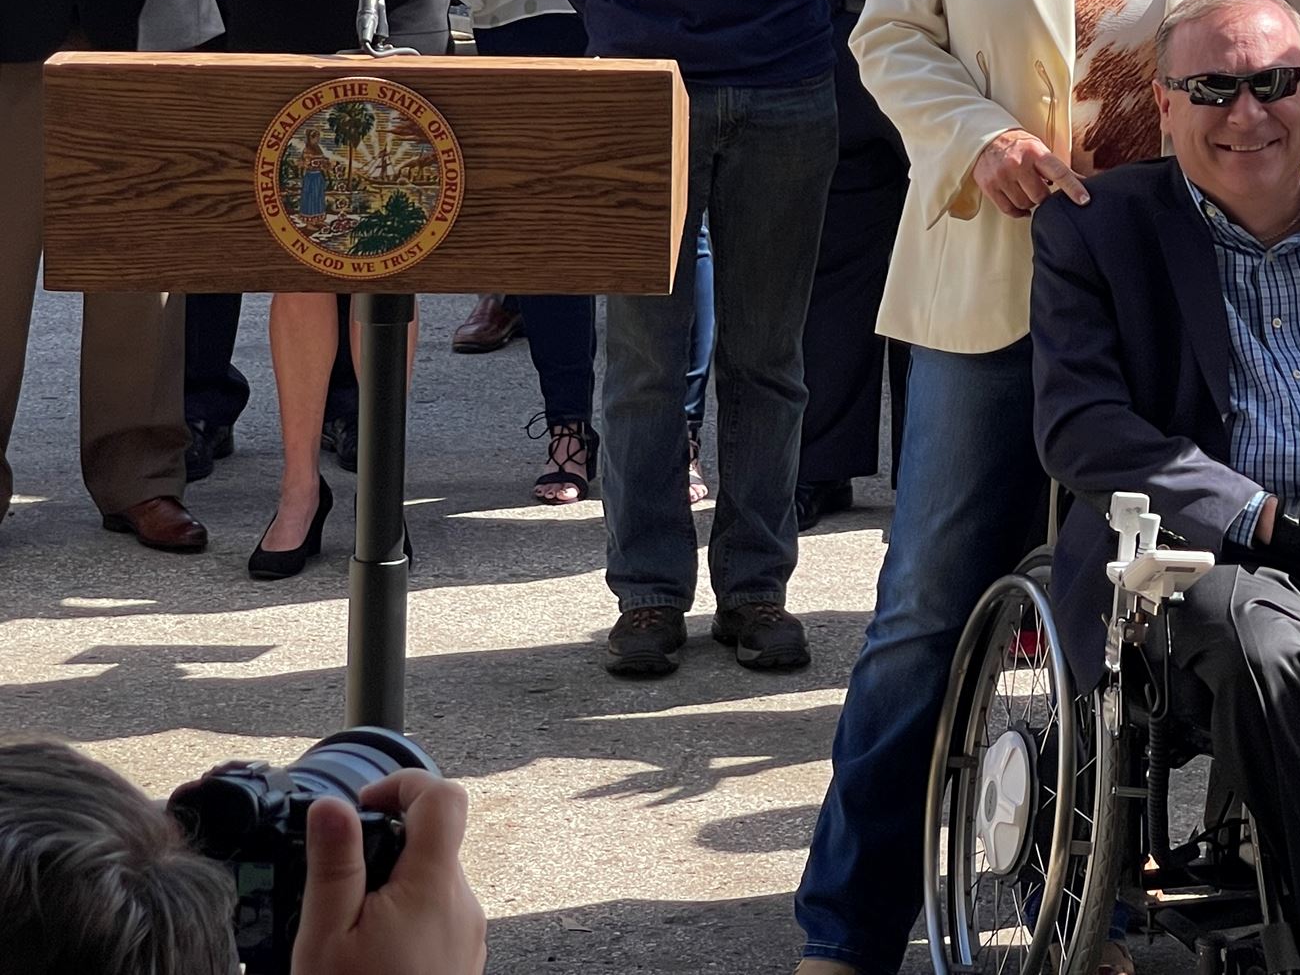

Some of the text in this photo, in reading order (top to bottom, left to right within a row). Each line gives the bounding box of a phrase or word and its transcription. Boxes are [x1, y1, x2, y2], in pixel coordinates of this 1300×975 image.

[260, 83, 459, 224] GREAT SEAL OF THE STATE OF FLORIDA
[290, 238, 424, 273] IN GOD WE TRUST
